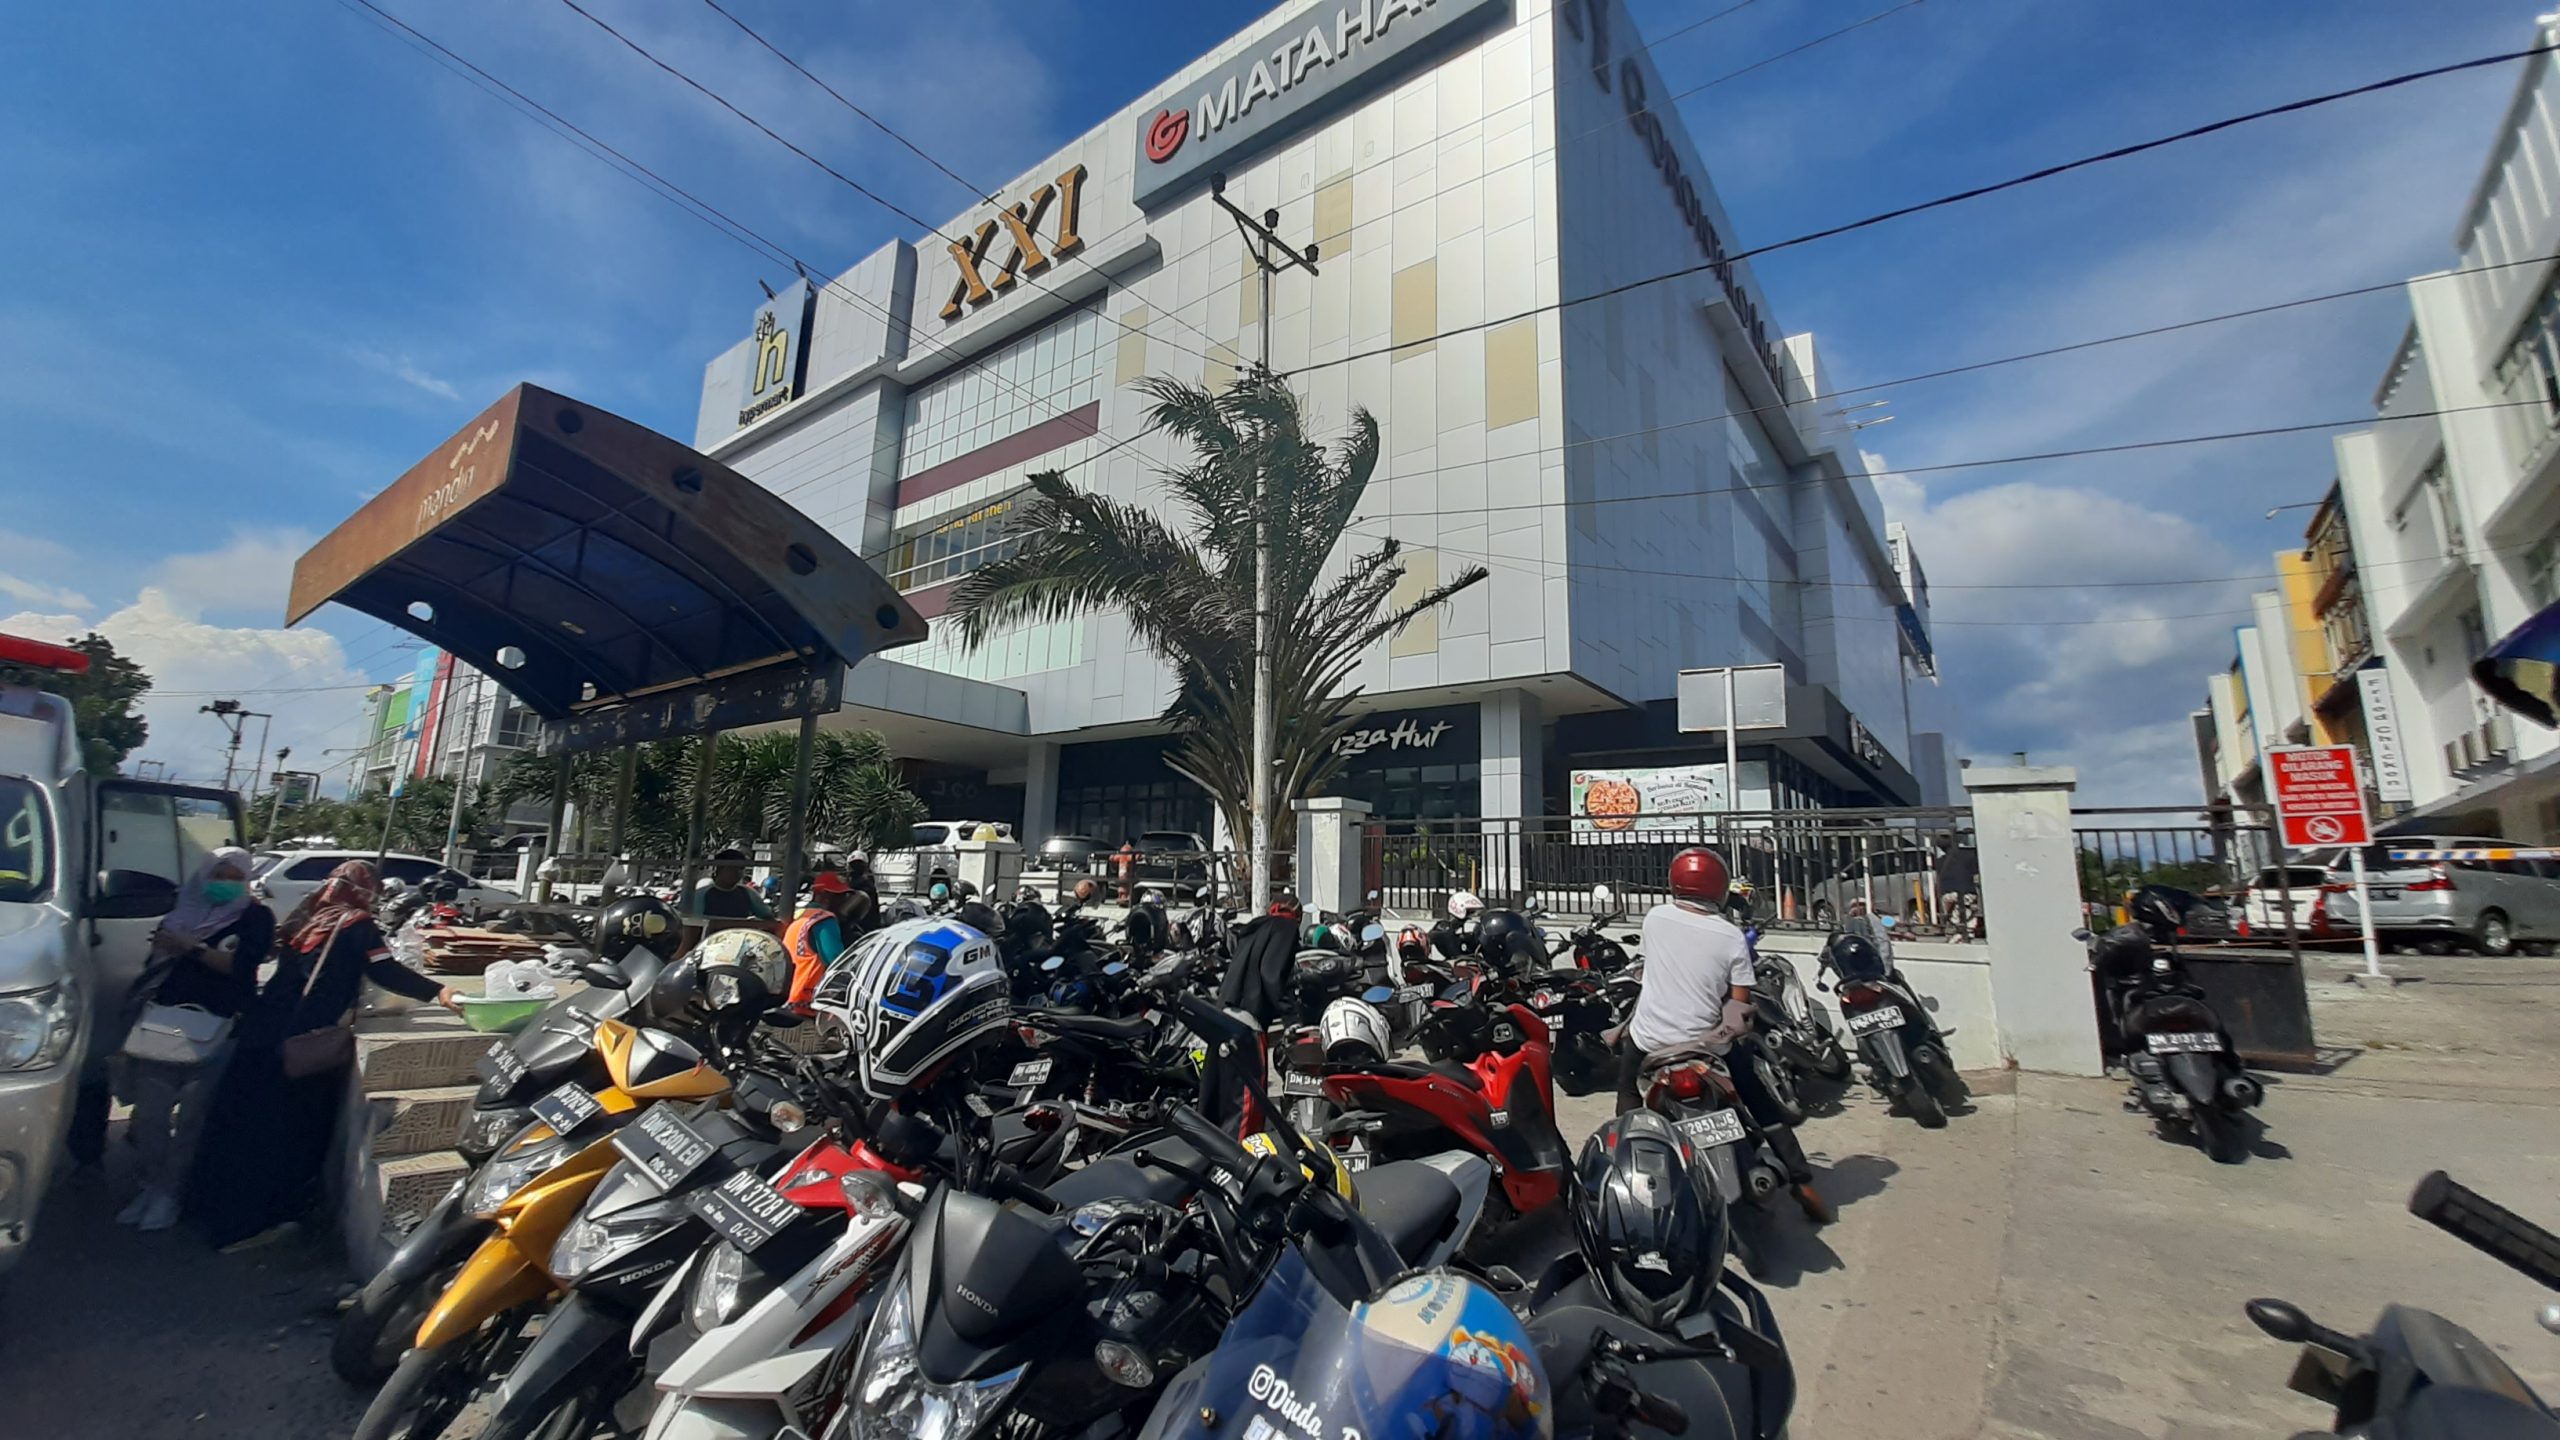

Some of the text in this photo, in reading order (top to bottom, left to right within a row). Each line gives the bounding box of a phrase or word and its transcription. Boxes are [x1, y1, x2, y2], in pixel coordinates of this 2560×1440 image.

[1196, 0, 1438, 141] MATAHA
[939, 163, 1087, 320] XXI
[739, 386, 789, 426] hypermart
[1389, 718, 1454, 750] Hut
[2280, 760, 2345, 773] DILARANG
[2285, 751, 2332, 762] MOTOR
[2290, 770, 2338, 782] MASUK
[963, 945, 991, 965] GM
[639, 1111, 671, 1138] DM
[1687, 1117, 1716, 1135] 2851
[723, 1170, 756, 1196] DM
[740, 1183, 784, 1218] 3728
[767, 1204, 800, 1228] AT
[619, 1259, 676, 1285] HONDA
[956, 1284, 999, 1318] HONDA
